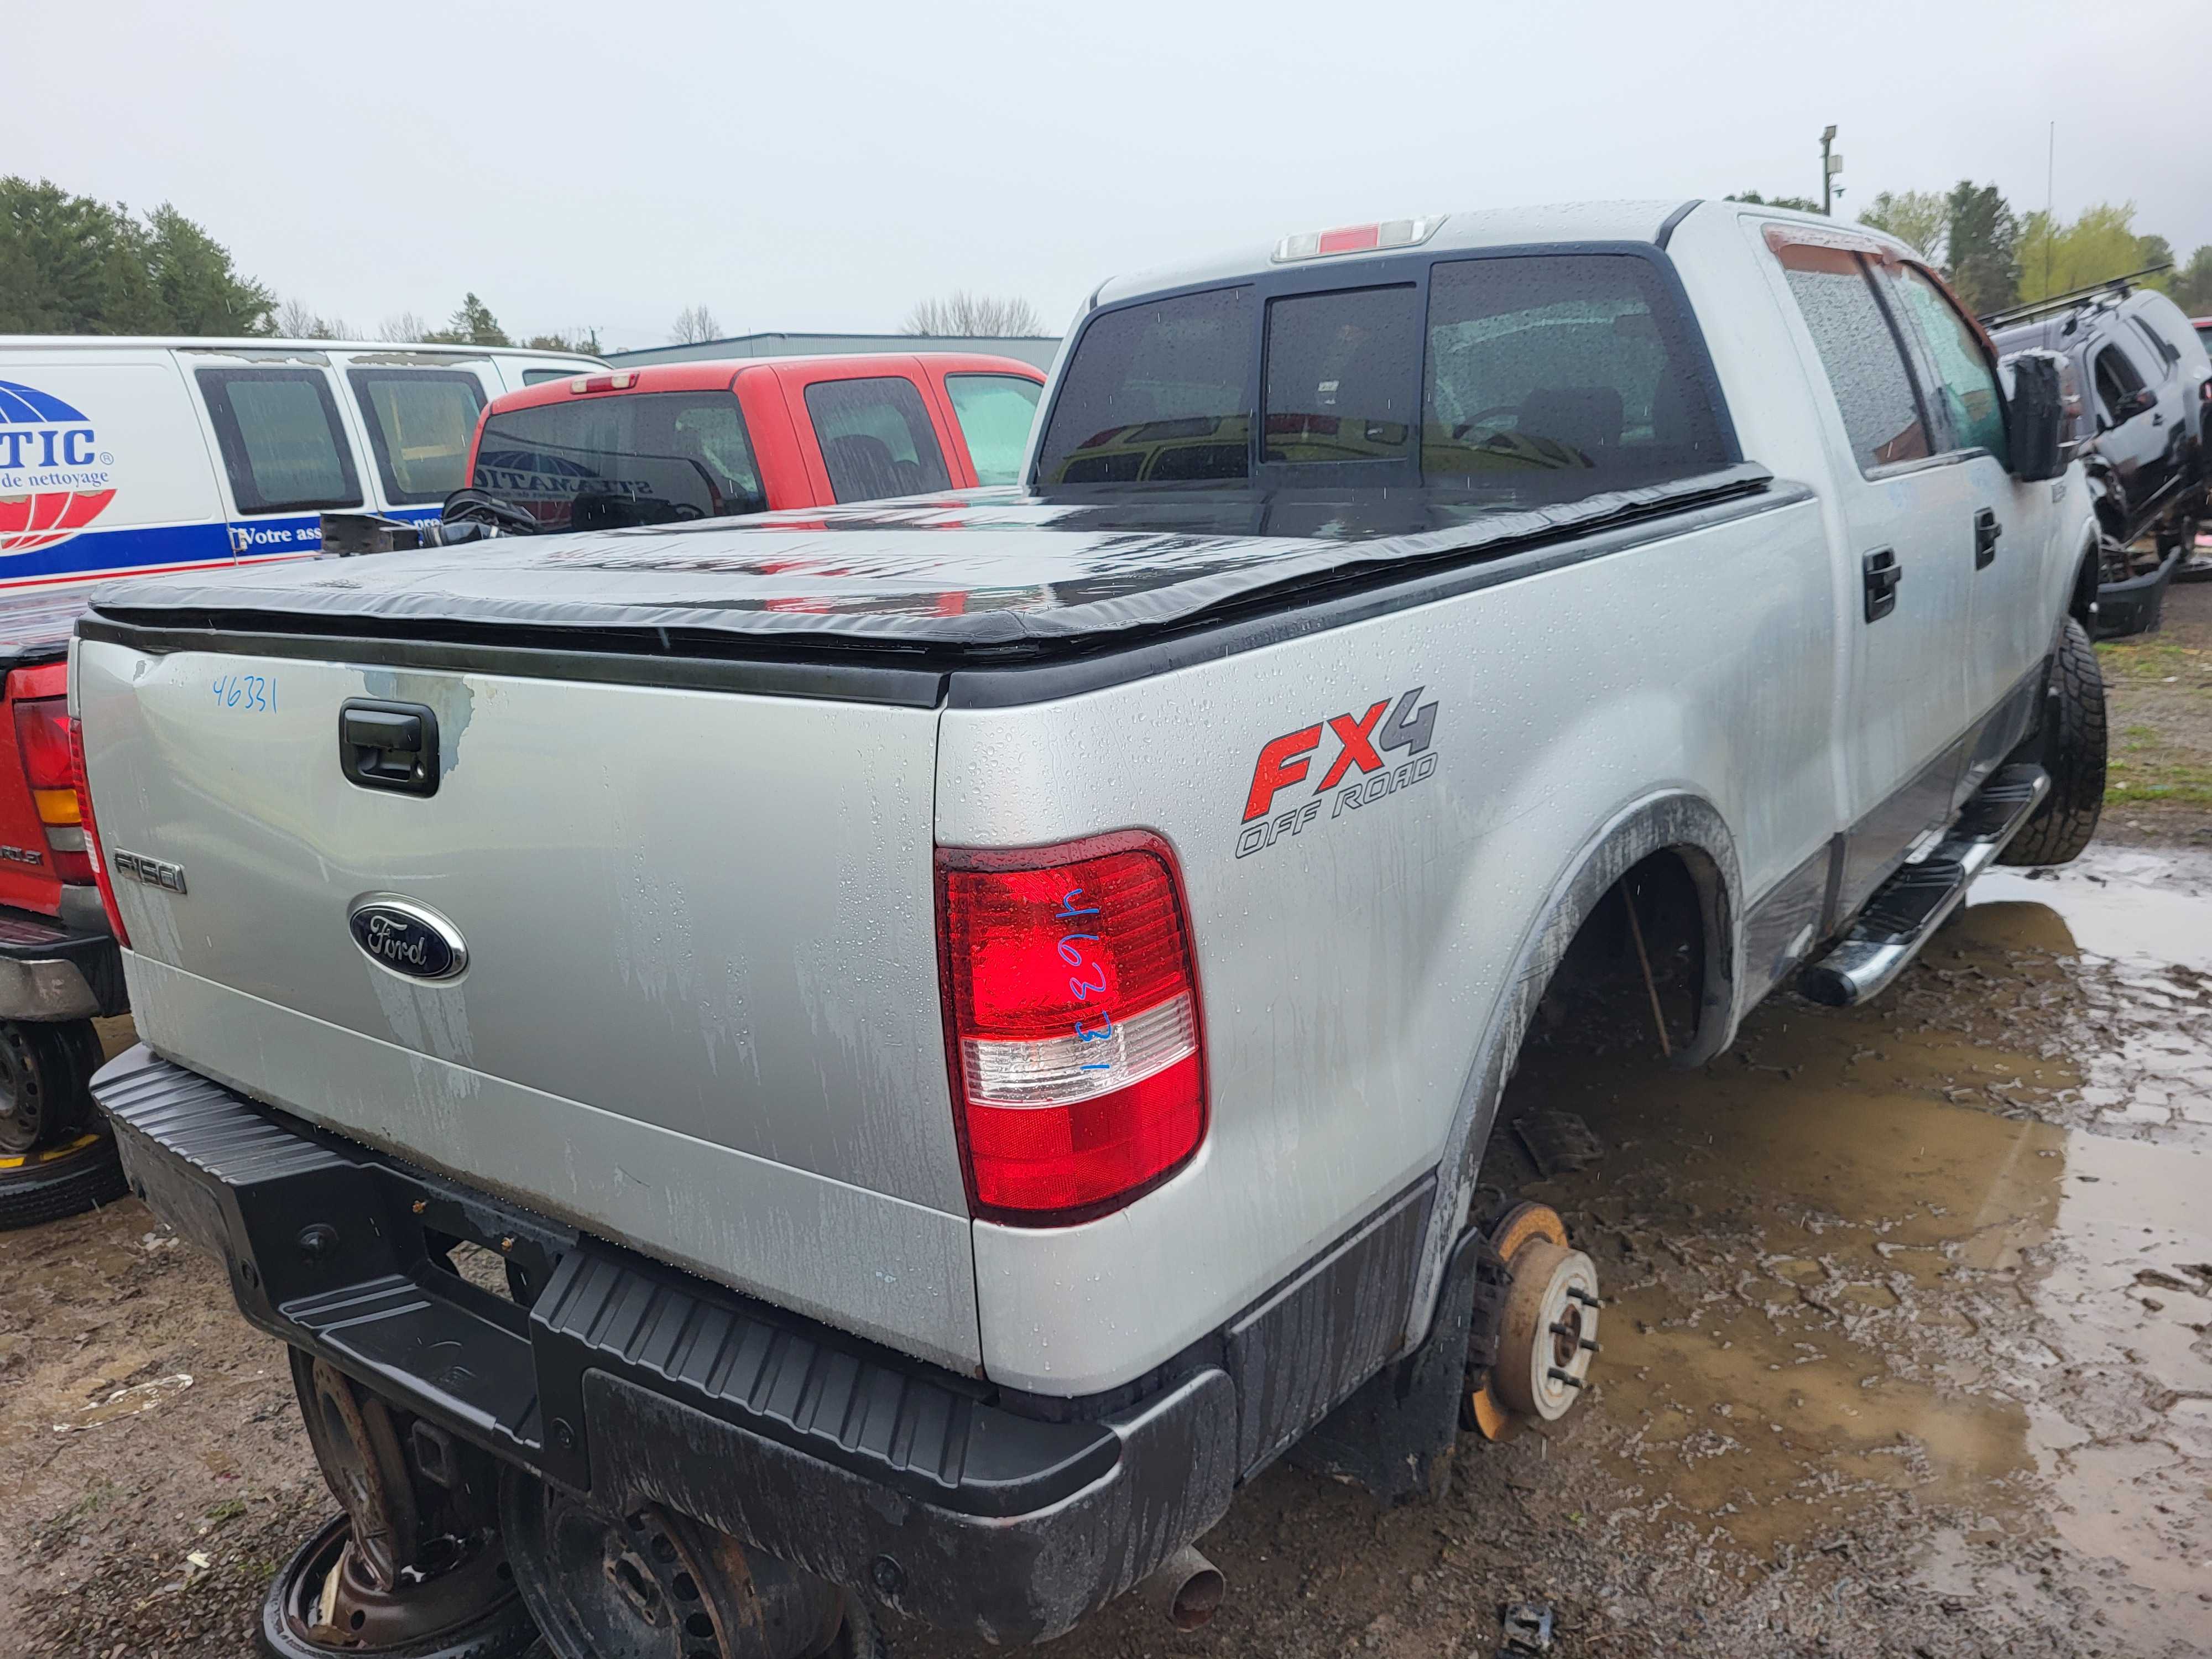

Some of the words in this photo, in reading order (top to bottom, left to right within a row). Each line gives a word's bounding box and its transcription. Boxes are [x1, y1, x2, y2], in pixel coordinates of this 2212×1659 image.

[0, 430, 95, 468] TIC
[2, 473, 23, 488] de
[28, 472, 109, 488] nettoyage
[244, 528, 293, 545] Votre
[213, 675, 277, 714] 46331
[1241, 686, 1439, 825] FX4
[1235, 799, 1322, 859] OFF
[1332, 752, 1438, 819] ROAD
[367, 915, 427, 966] Ford
[1056, 888, 1112, 1071] 46331
